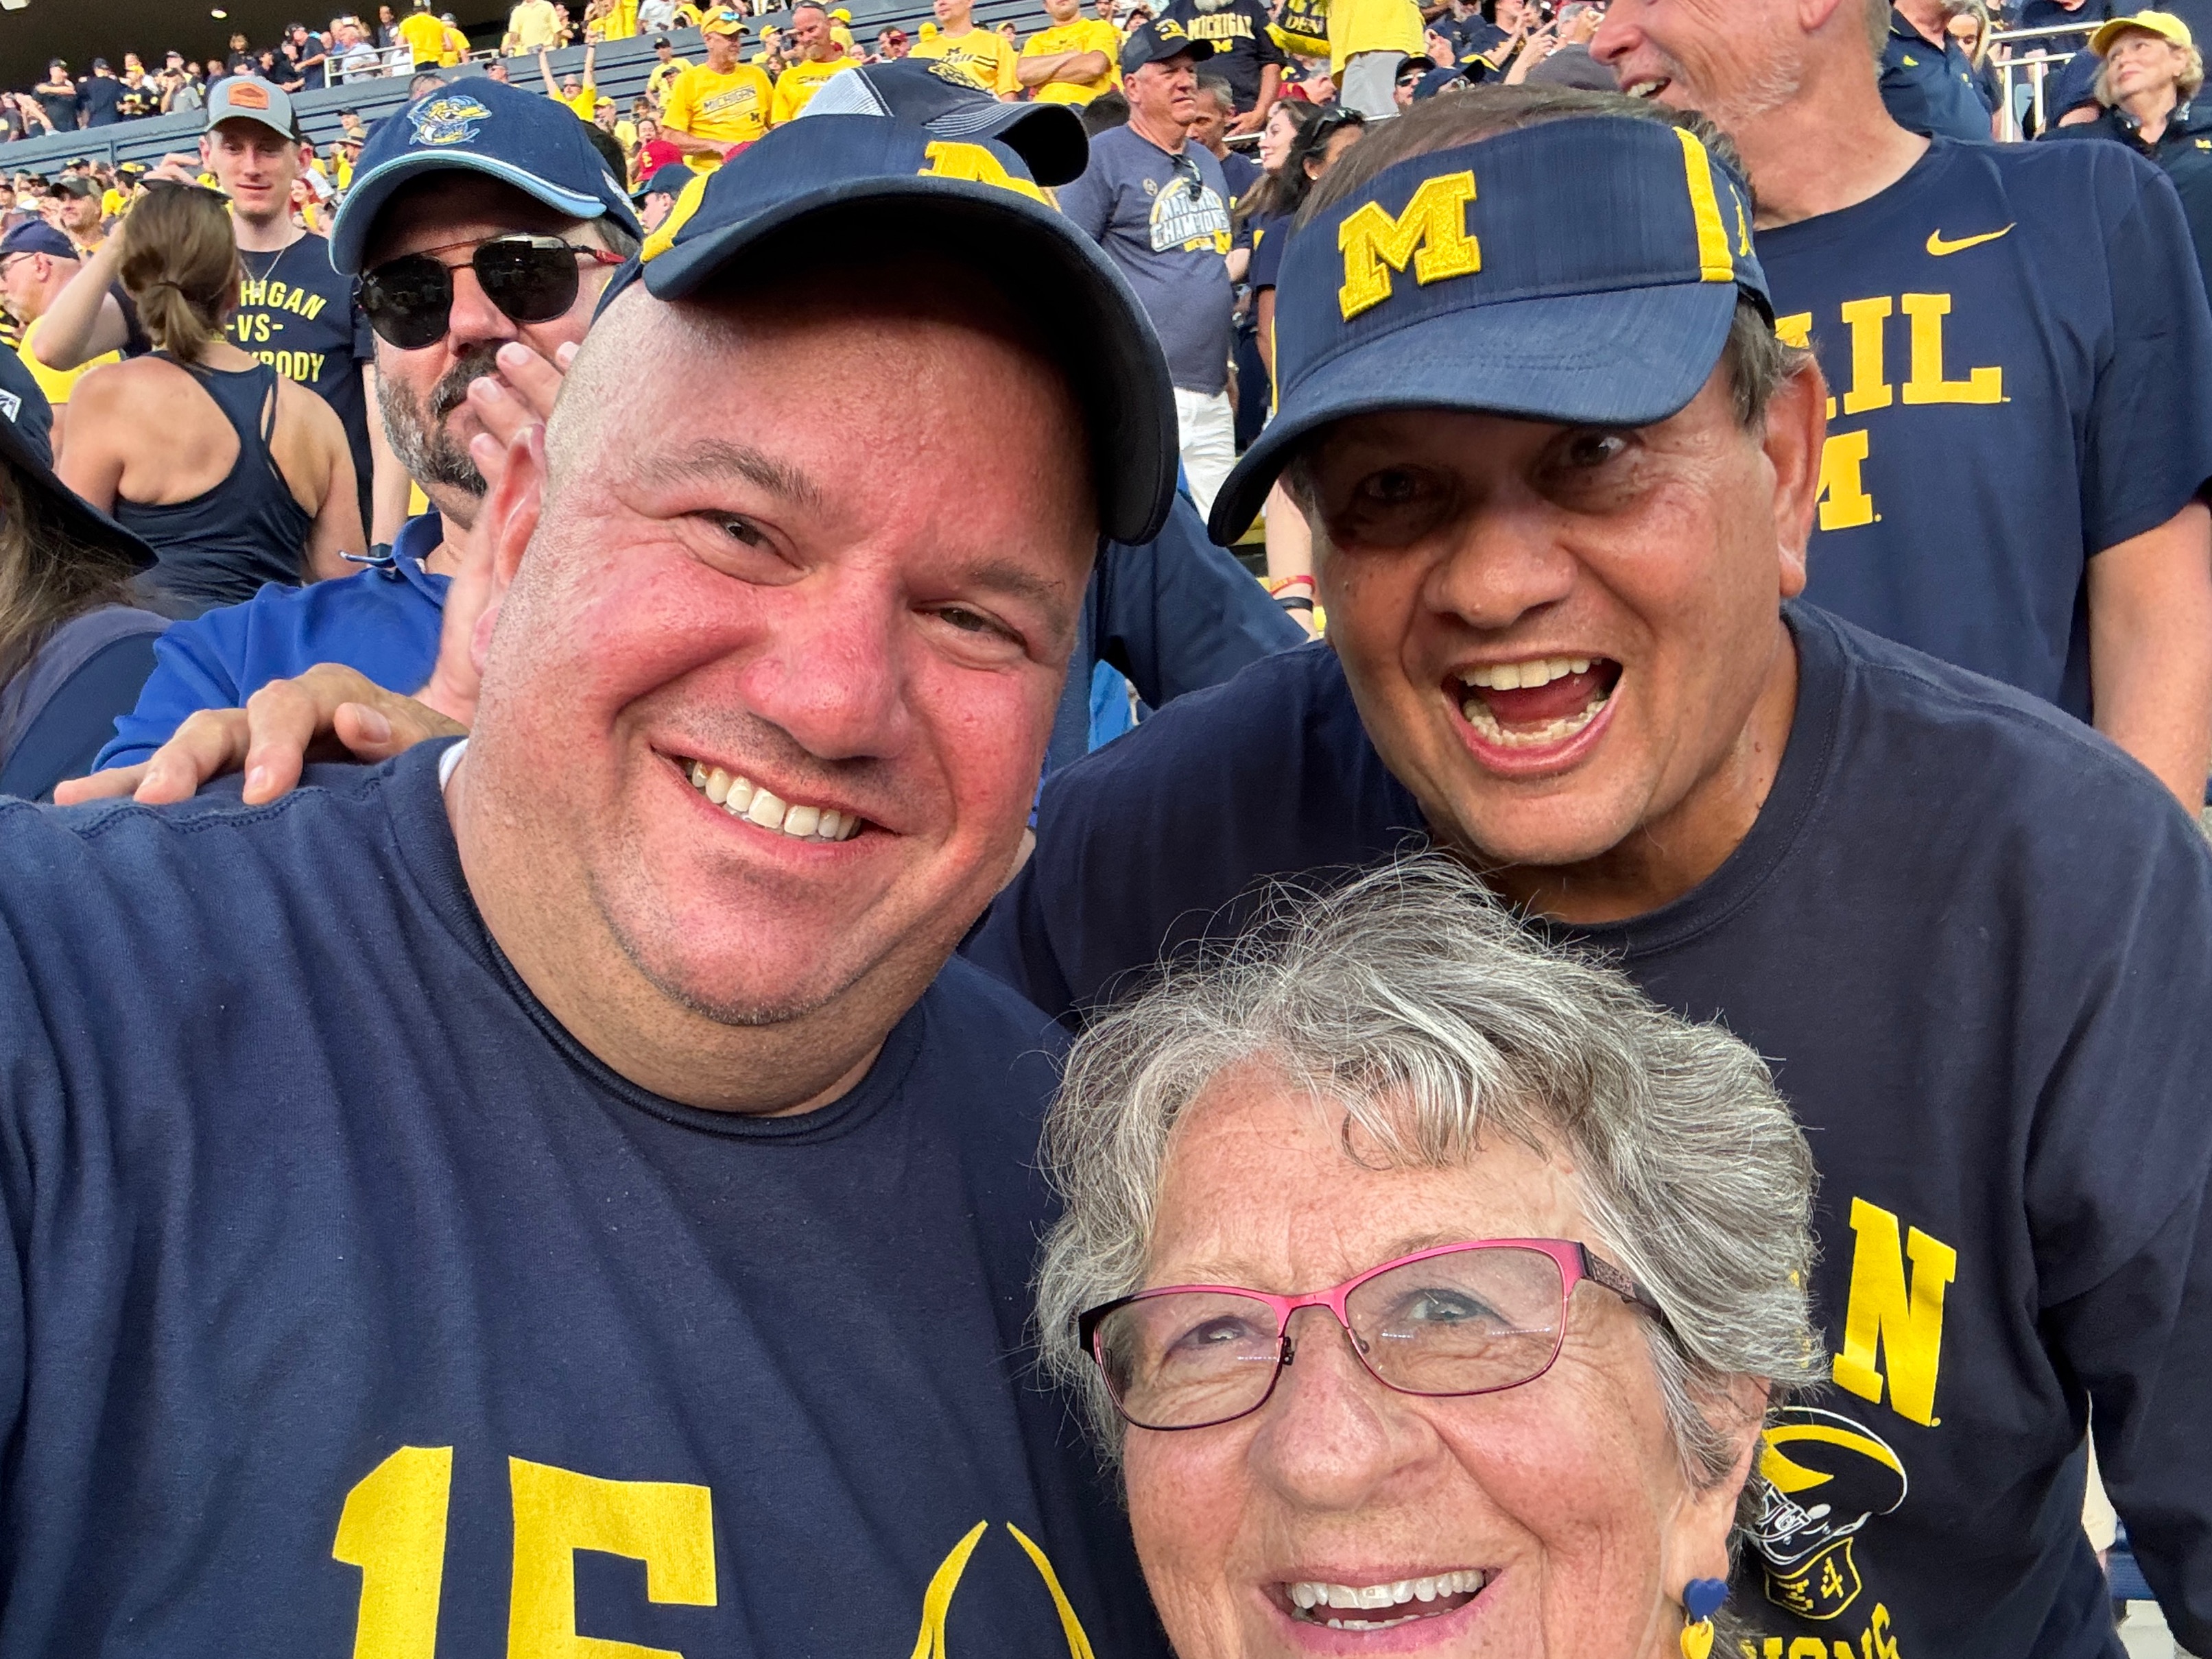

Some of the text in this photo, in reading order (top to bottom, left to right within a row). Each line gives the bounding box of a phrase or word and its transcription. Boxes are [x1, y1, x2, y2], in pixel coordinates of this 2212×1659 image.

[1187, 12, 1256, 40] MICHIGAN
[1338, 169, 1482, 322] M
[241, 280, 327, 320] HIGAN
